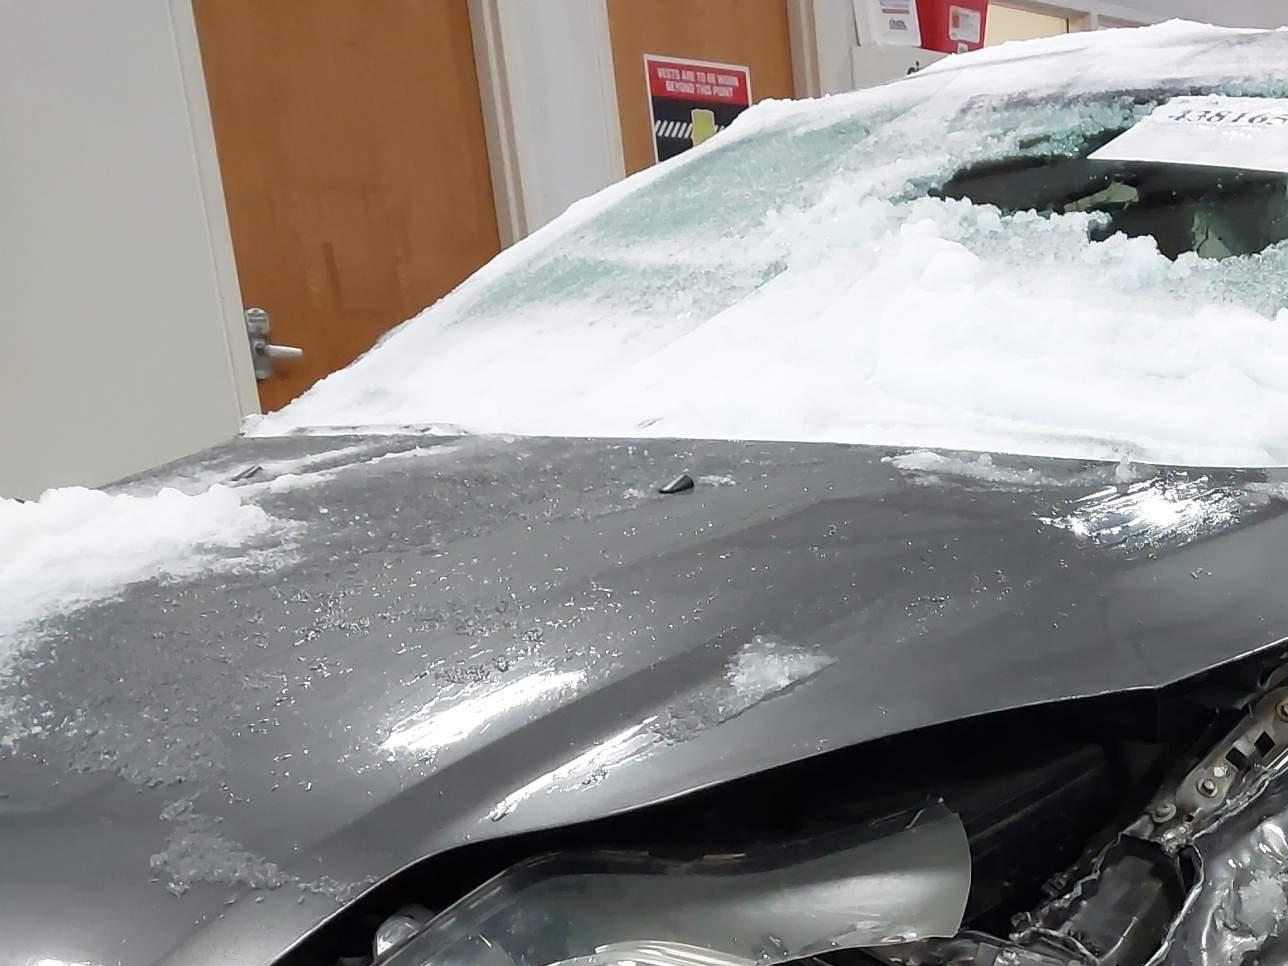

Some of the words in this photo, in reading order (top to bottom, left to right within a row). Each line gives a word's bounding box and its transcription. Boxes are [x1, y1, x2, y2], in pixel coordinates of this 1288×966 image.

[657, 67, 680, 80] VESTS
[681, 70, 695, 81] ARE
[697, 72, 706, 83] TO
[666, 80, 694, 93] BEYOND
[696, 85, 711, 96] THIS
[713, 87, 733, 97] POINT
